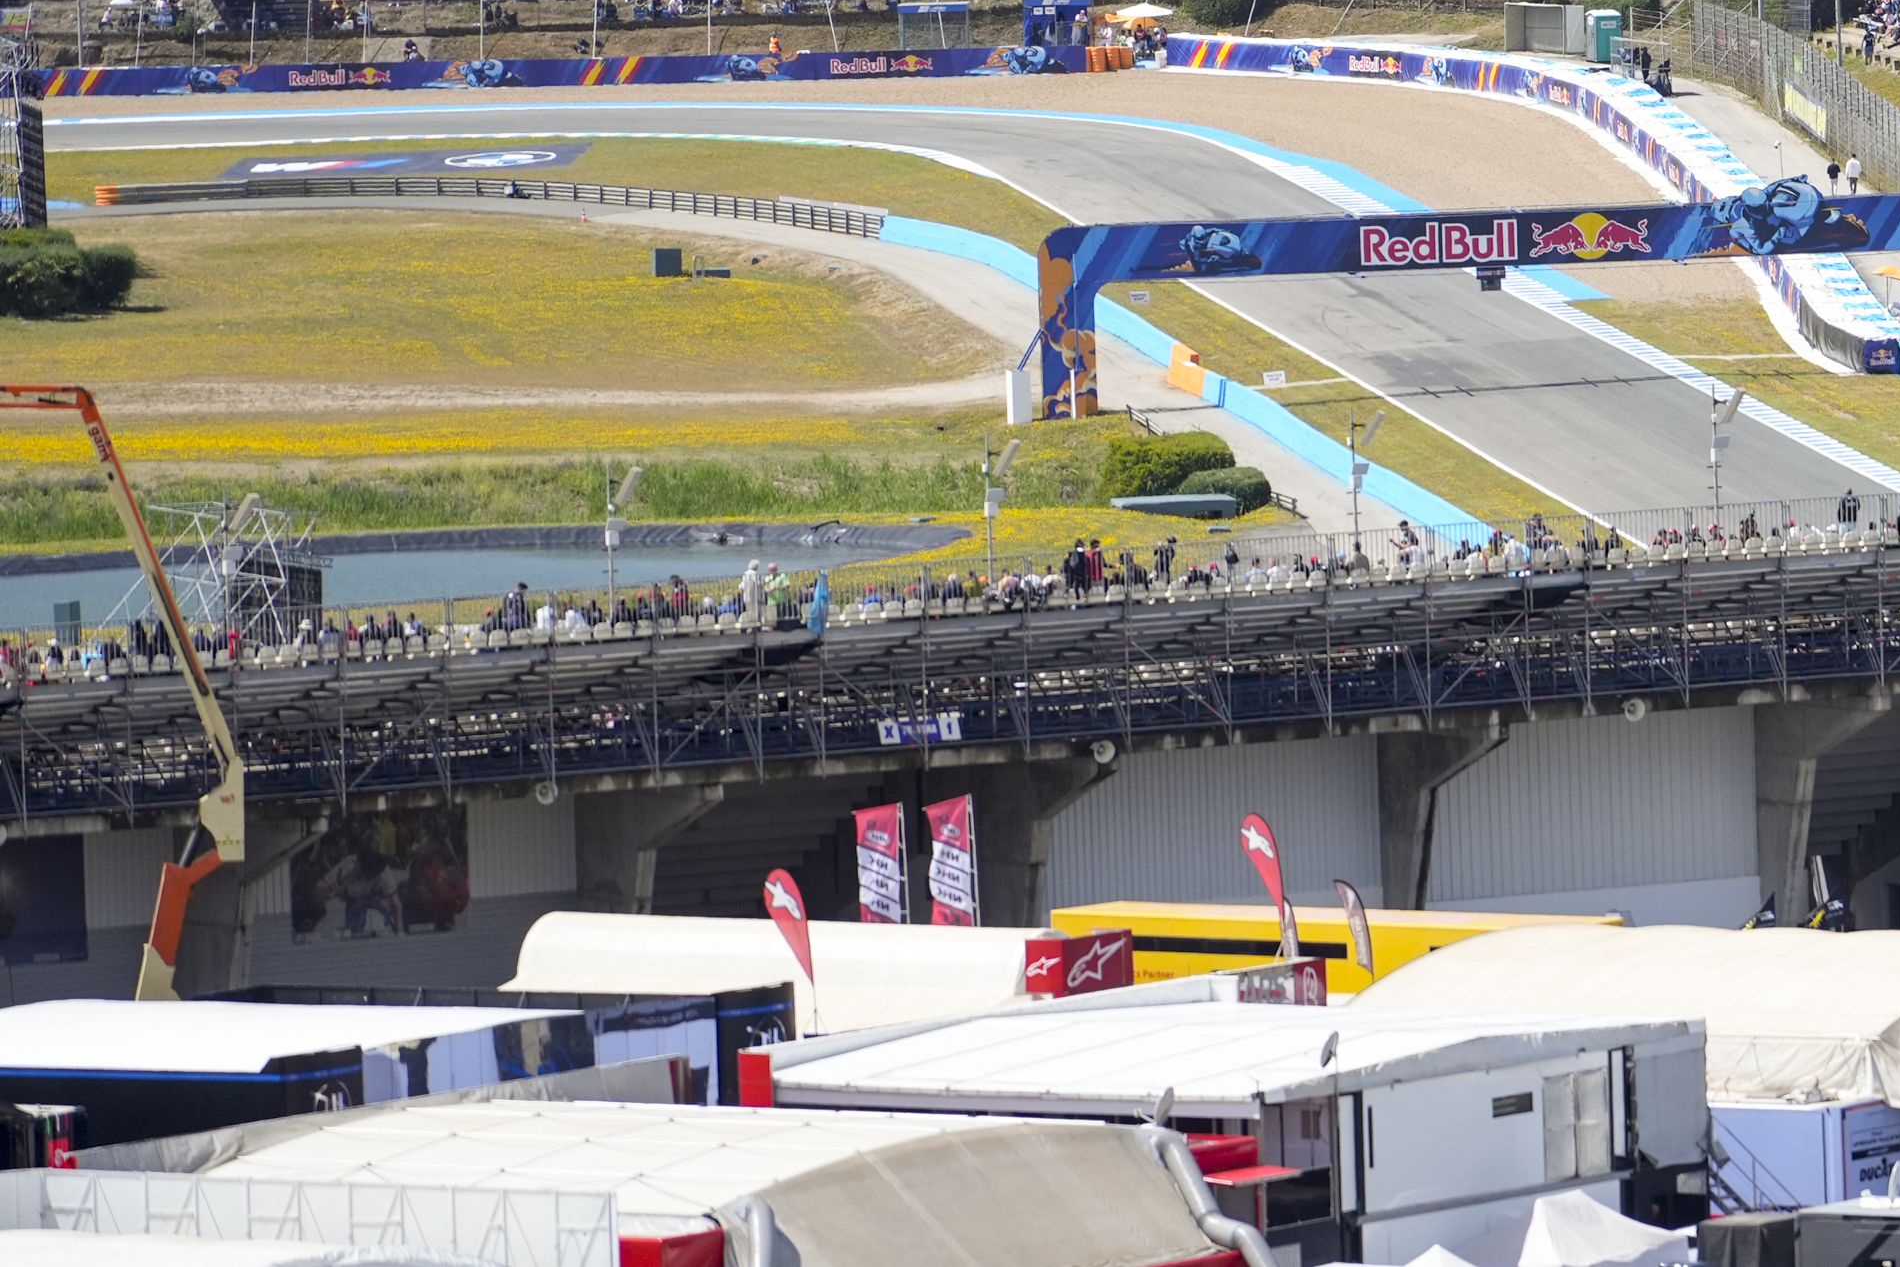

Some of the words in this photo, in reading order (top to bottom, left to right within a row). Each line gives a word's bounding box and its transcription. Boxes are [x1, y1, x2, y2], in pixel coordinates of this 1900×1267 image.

[830, 58, 859, 73] Red
[860, 57, 887, 73] Bull
[1349, 55, 1364, 71] Red
[1363, 56, 1380, 72] Bull
[288, 70, 318, 86] Red
[318, 69, 345, 85] Bull
[1360, 222, 1440, 266] Red
[1442, 219, 1519, 263] Bull
[1143, 969, 1174, 979] Partner
